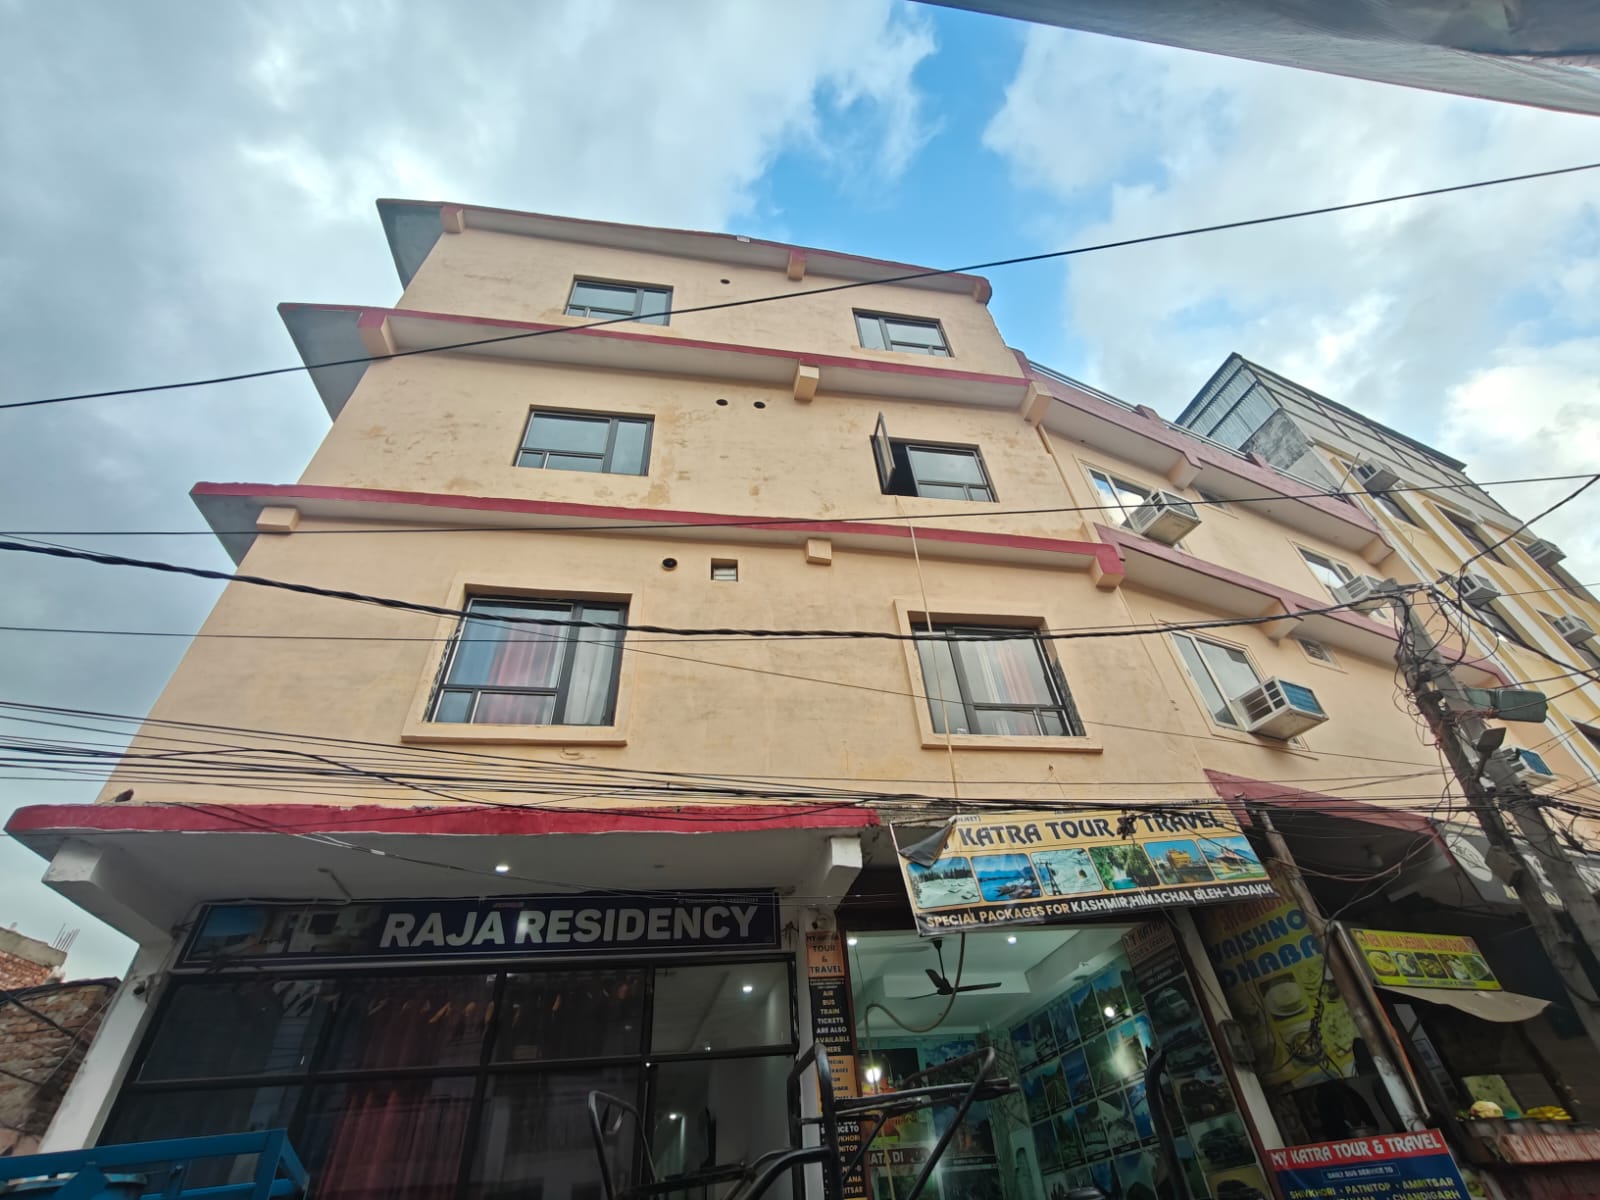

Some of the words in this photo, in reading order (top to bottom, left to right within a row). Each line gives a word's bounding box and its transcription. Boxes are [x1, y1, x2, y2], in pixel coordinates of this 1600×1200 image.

[957, 824, 1042, 847] KATRA
[1045, 818, 1115, 840] TOUR
[1138, 811, 1224, 832] TRAVEL
[379, 911, 505, 948] RAJA
[514, 906, 758, 944] RESIDENCY
[926, 913, 979, 928] SPECIAL
[979, 905, 1046, 922] PACKAGES
[1046, 903, 1072, 916] FOR
[1208, 909, 1307, 963] VAISHNO
[809, 966, 842, 974] TRAVEL
[1219, 935, 1324, 987] DHABA
[892, 1151, 904, 1162] DI
[1271, 1152, 1289, 1168] MY
[1291, 1146, 1333, 1163] KATRA
[1332, 1141, 1372, 1158] TOUR
[1373, 1141, 1384, 1154] &
[1384, 1133, 1442, 1153] TRAVEL
[1357, 1167, 1384, 1176] SERVICE
[1345, 1182, 1391, 1194] PATNITOP
[1402, 1177, 1454, 1189] AMRITSAR
[1392, 1189, 1461, 1200] CHANDIGARH
